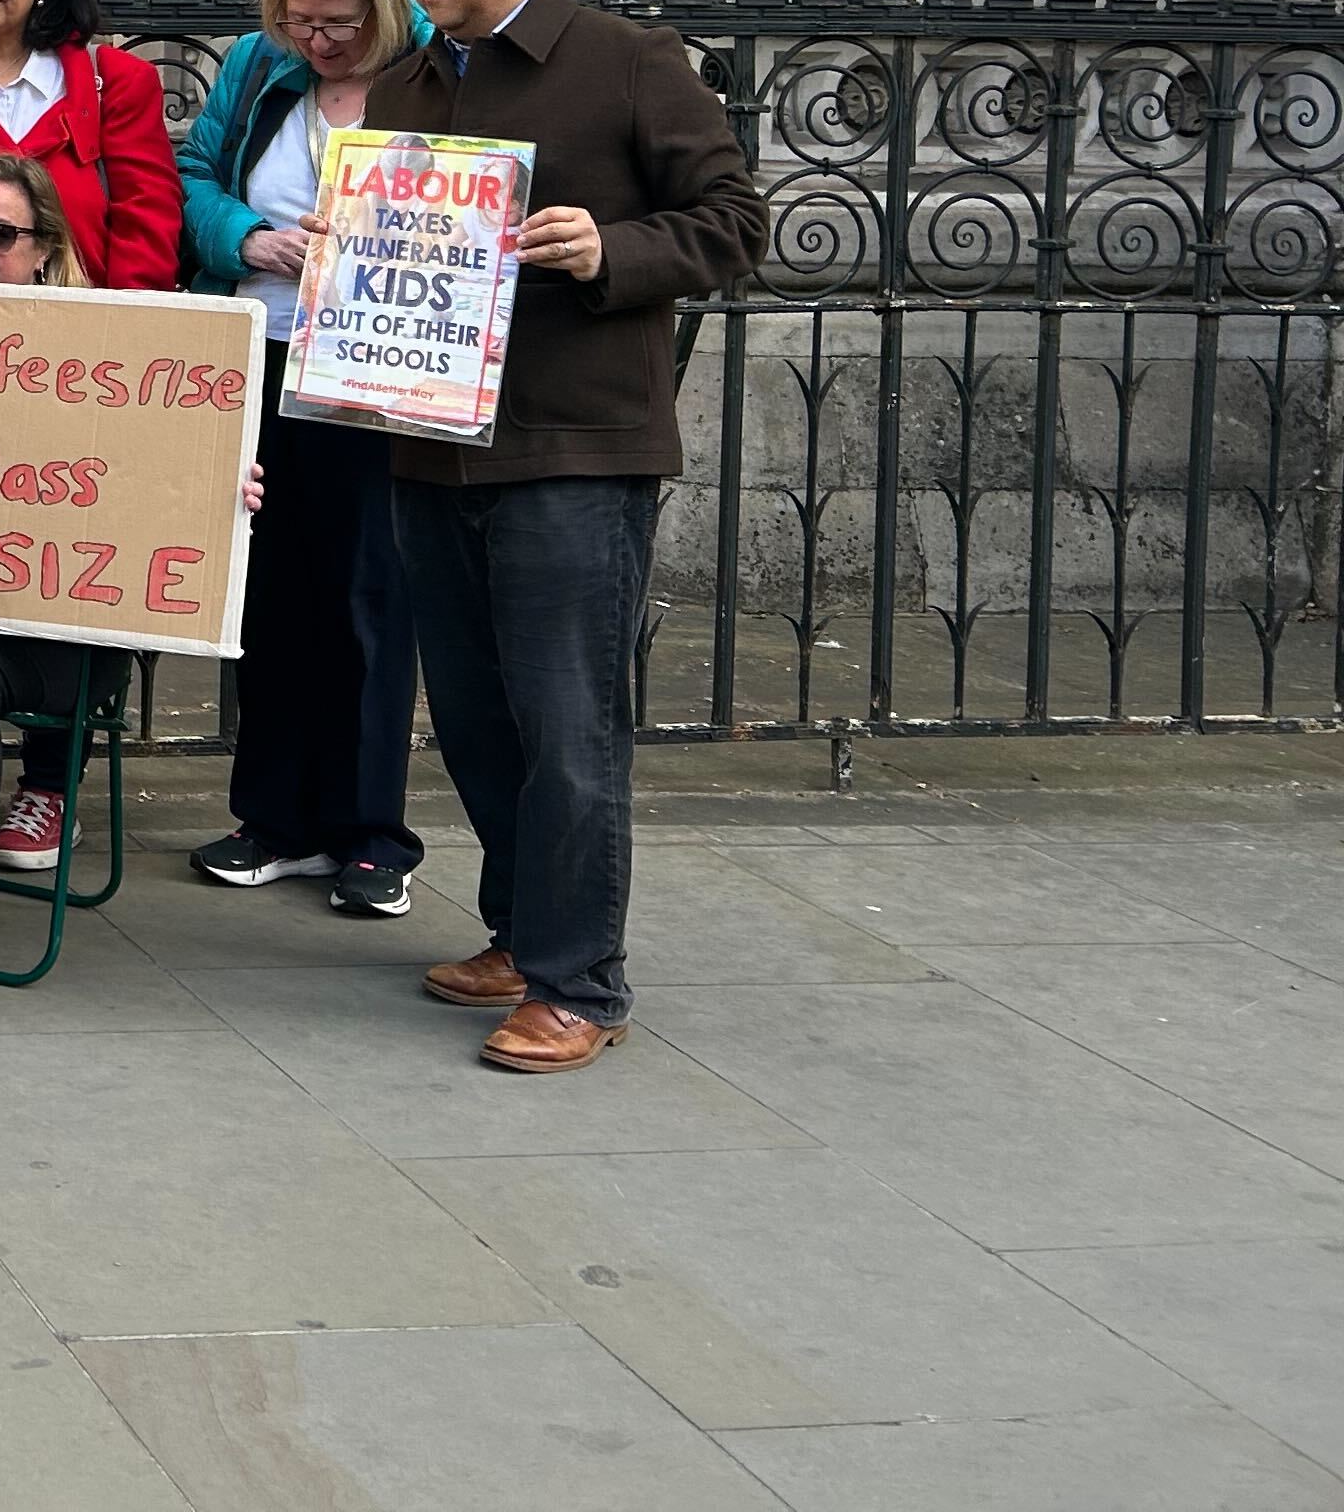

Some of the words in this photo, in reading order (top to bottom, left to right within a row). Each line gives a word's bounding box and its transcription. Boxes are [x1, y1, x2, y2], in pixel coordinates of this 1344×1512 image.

[339, 163, 501, 210] LABOUR
[375, 207, 453, 236] TAXES
[335, 233, 487, 270] VULNERABLE
[352, 264, 455, 312] KIDS
[318, 307, 366, 331] OUT
[372, 313, 407, 336] OF
[413, 318, 480, 348] THEIR
[335, 339, 451, 375] SCHOOLS
